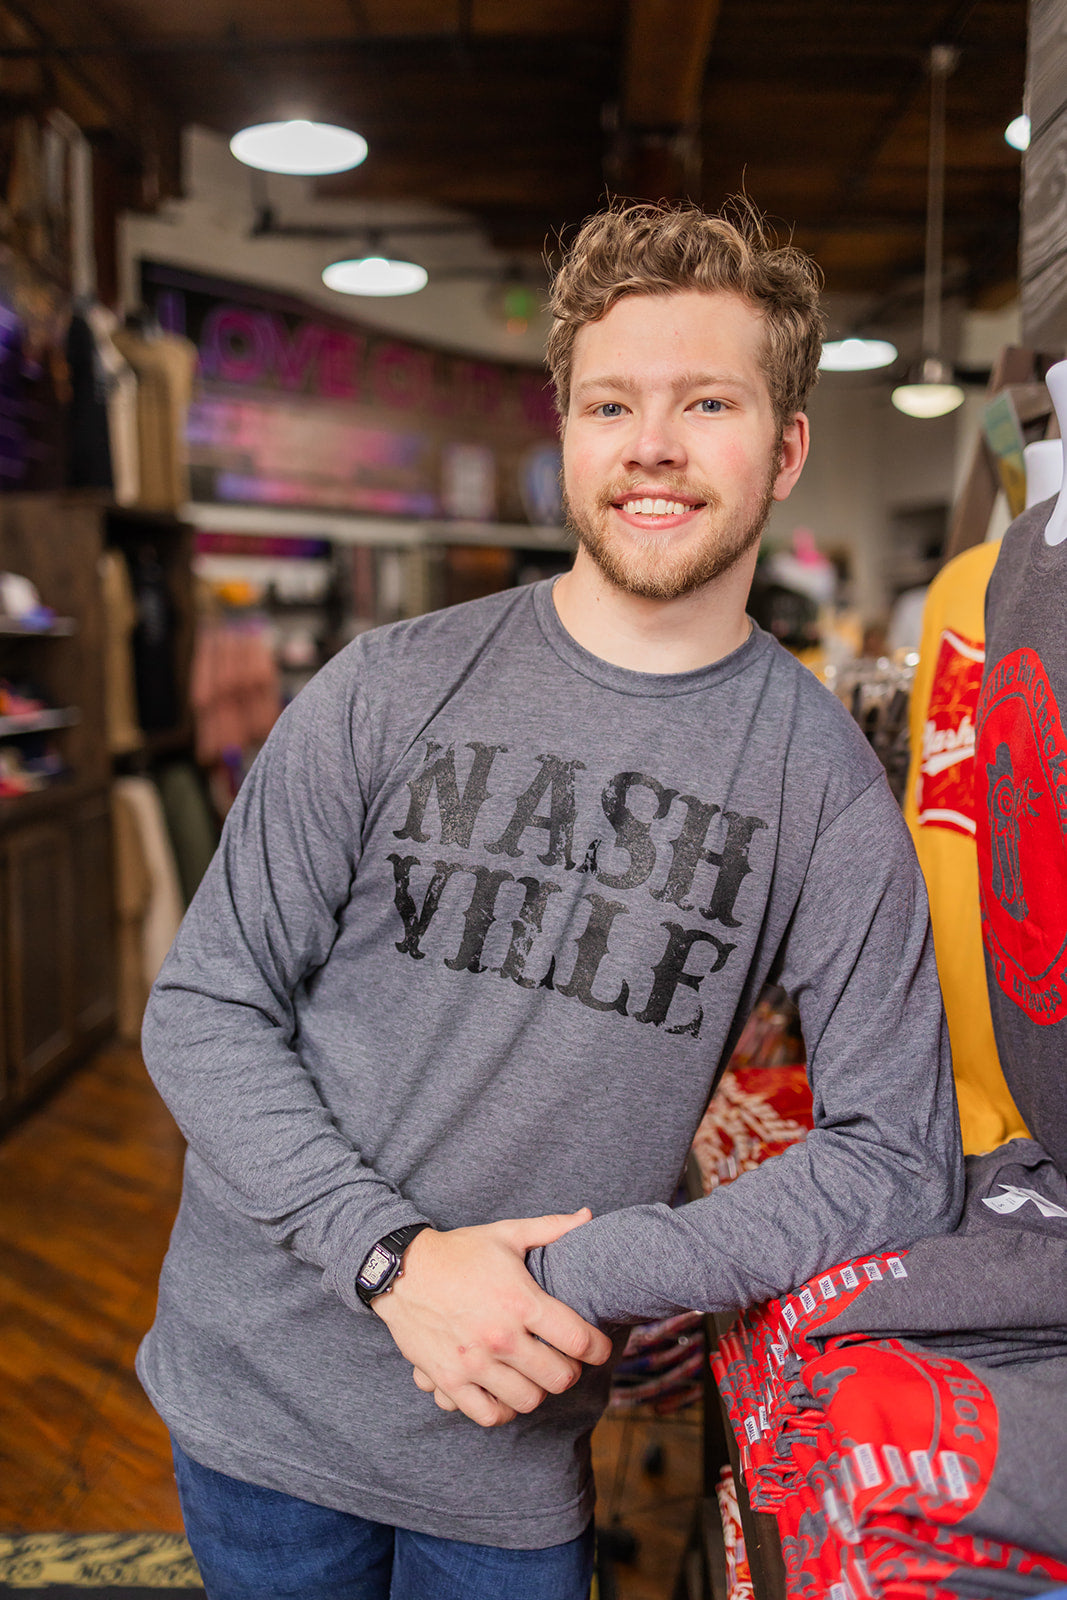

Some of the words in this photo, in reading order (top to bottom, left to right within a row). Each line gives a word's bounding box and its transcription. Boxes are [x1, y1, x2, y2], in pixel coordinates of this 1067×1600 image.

[392, 737, 769, 928] NASH
[386, 853, 738, 1040] VILLE
[944, 1375, 985, 1443] Hot
